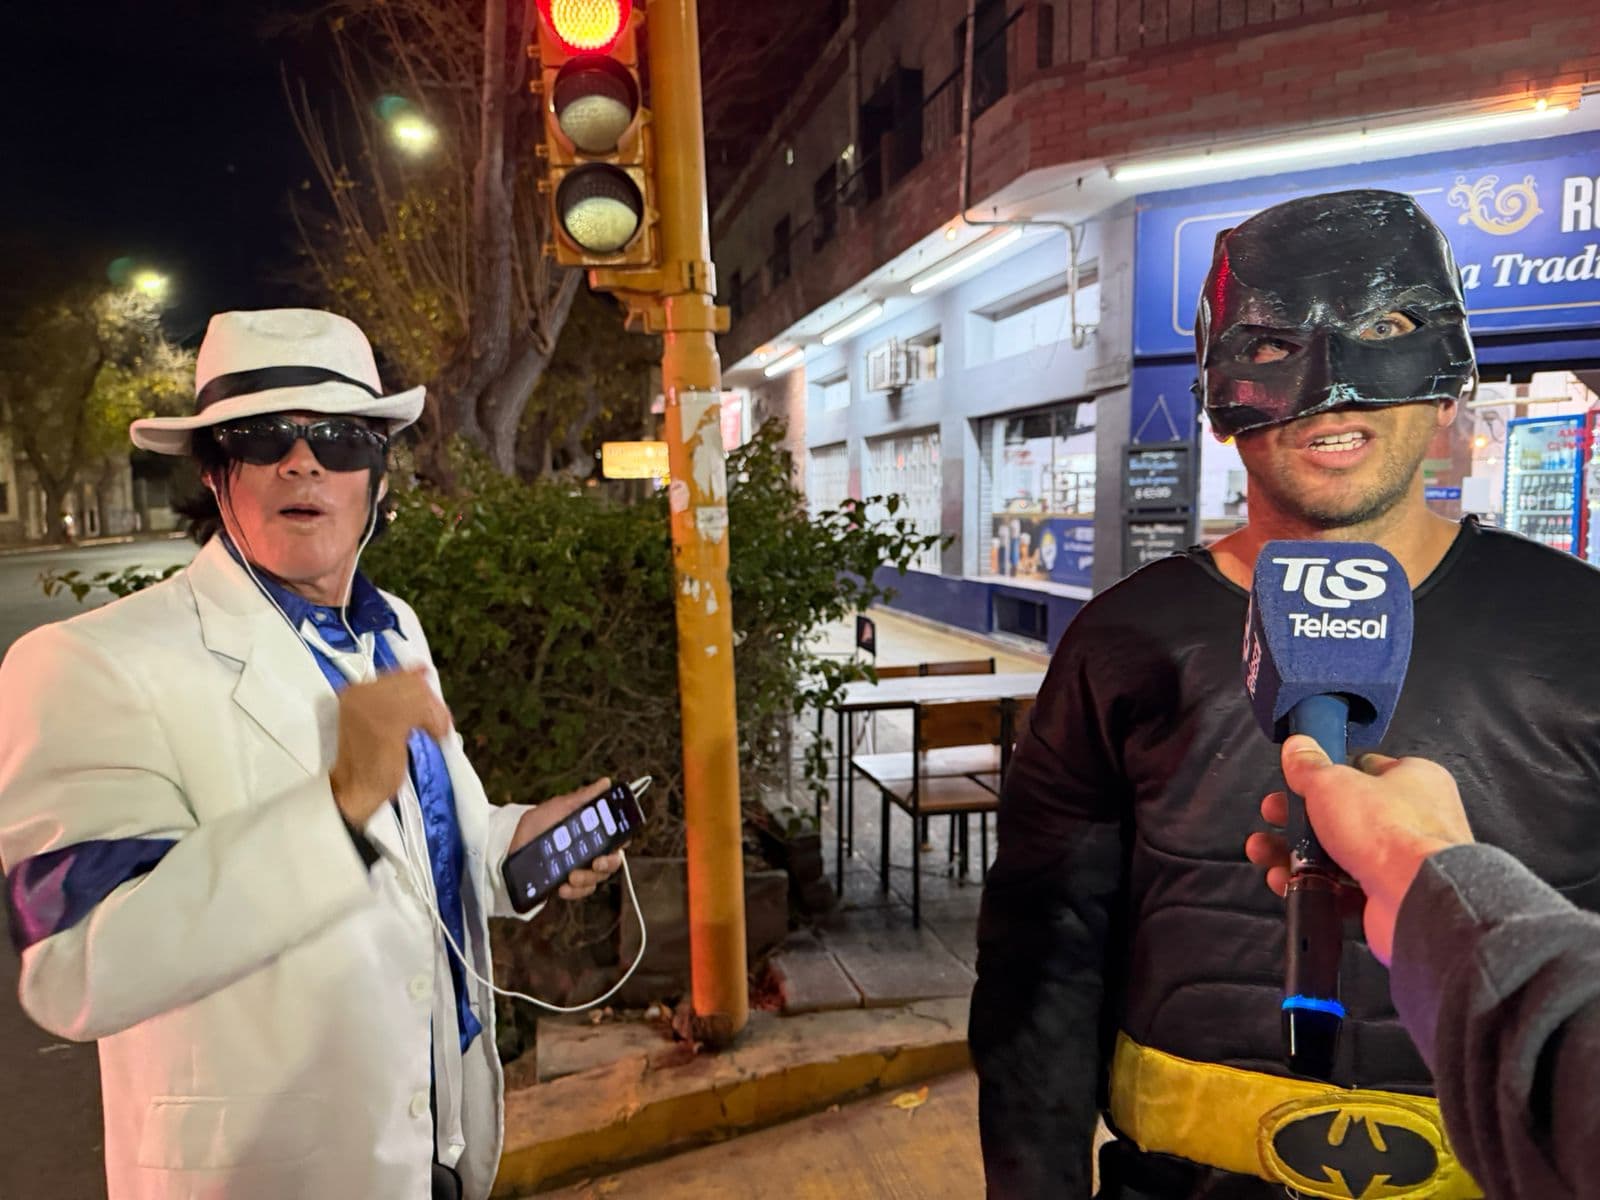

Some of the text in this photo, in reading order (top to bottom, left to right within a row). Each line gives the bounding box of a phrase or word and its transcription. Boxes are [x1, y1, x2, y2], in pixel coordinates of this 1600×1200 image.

[1561, 176, 1600, 233] R
[1461, 263, 1481, 290] a
[1272, 558, 1388, 608] TLS
[1289, 613, 1388, 640] Telesol
